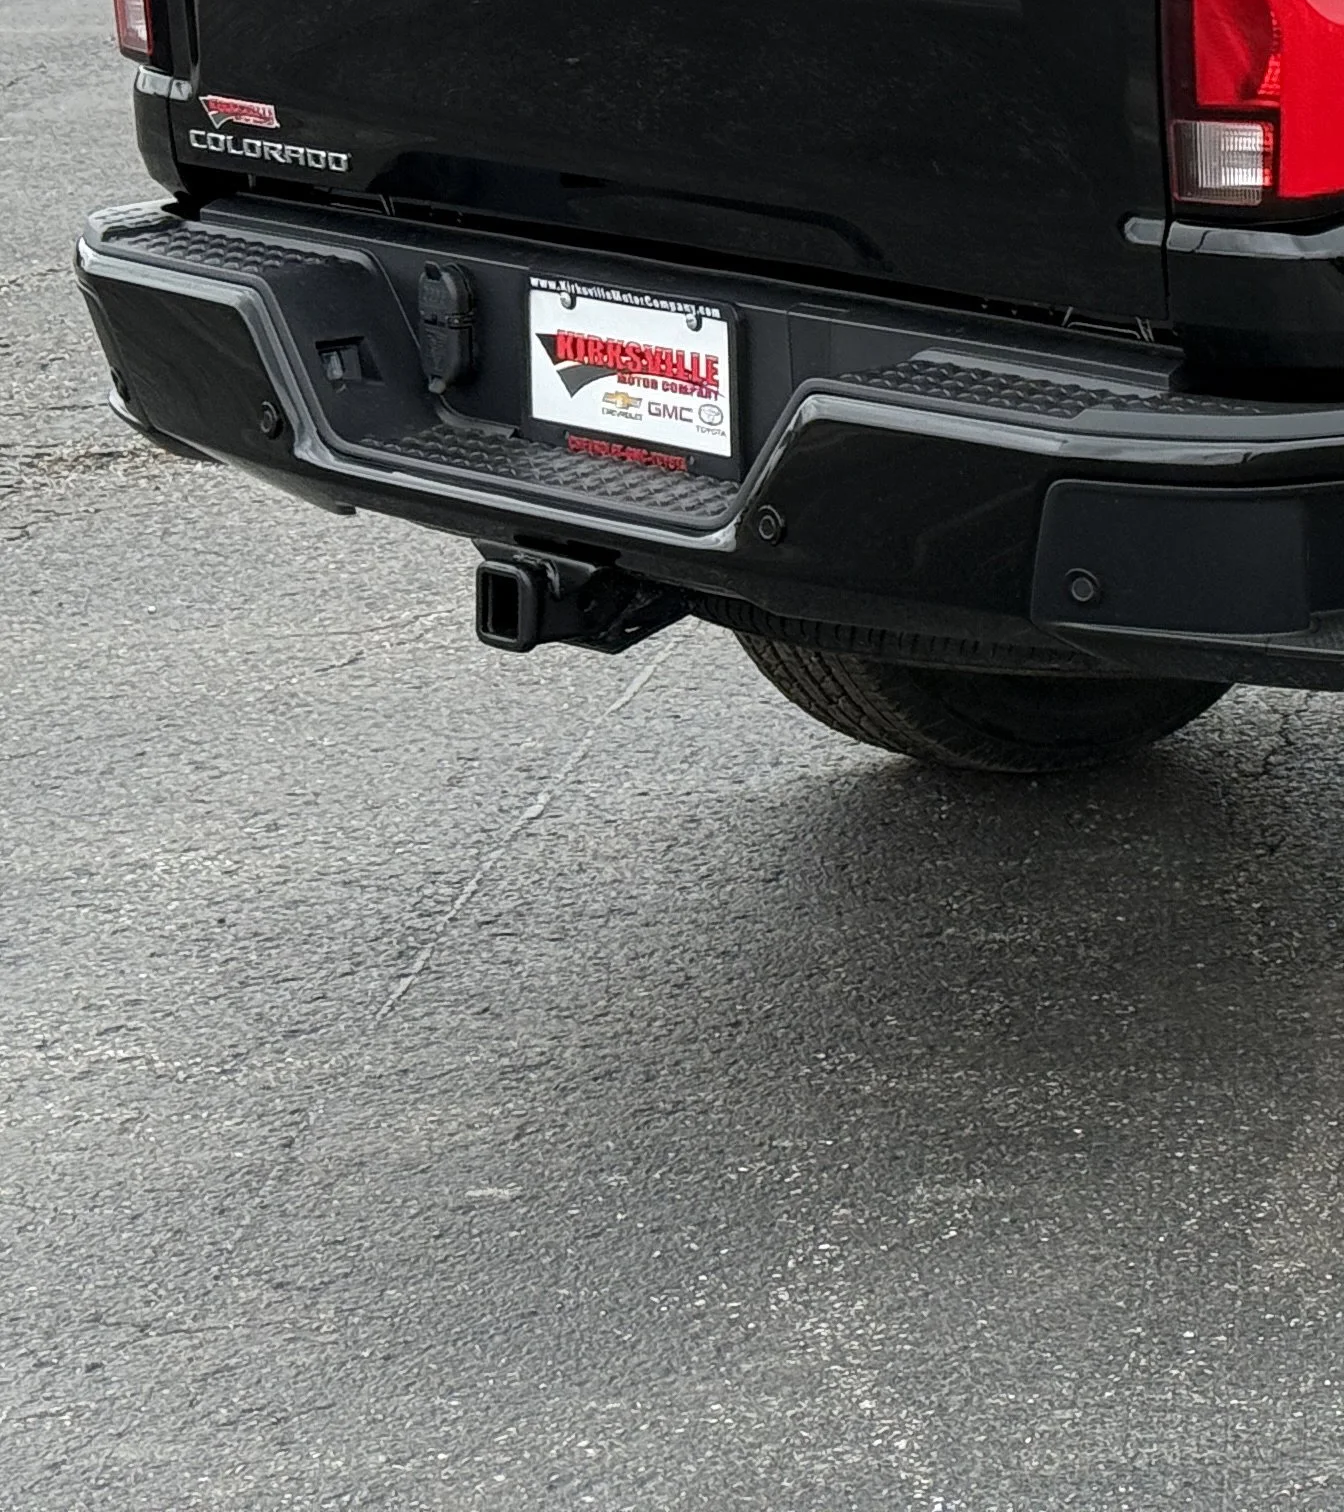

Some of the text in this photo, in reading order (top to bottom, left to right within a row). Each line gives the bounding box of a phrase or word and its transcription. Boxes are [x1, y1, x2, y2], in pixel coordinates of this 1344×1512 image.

[189, 129, 350, 172] COLORADO
[555, 329, 720, 388] KIRKSVILLE
[617, 373, 720, 401] MOTOR COMPANY
[647, 401, 693, 423] GMC
[695, 425, 727, 437] TOYOTA
